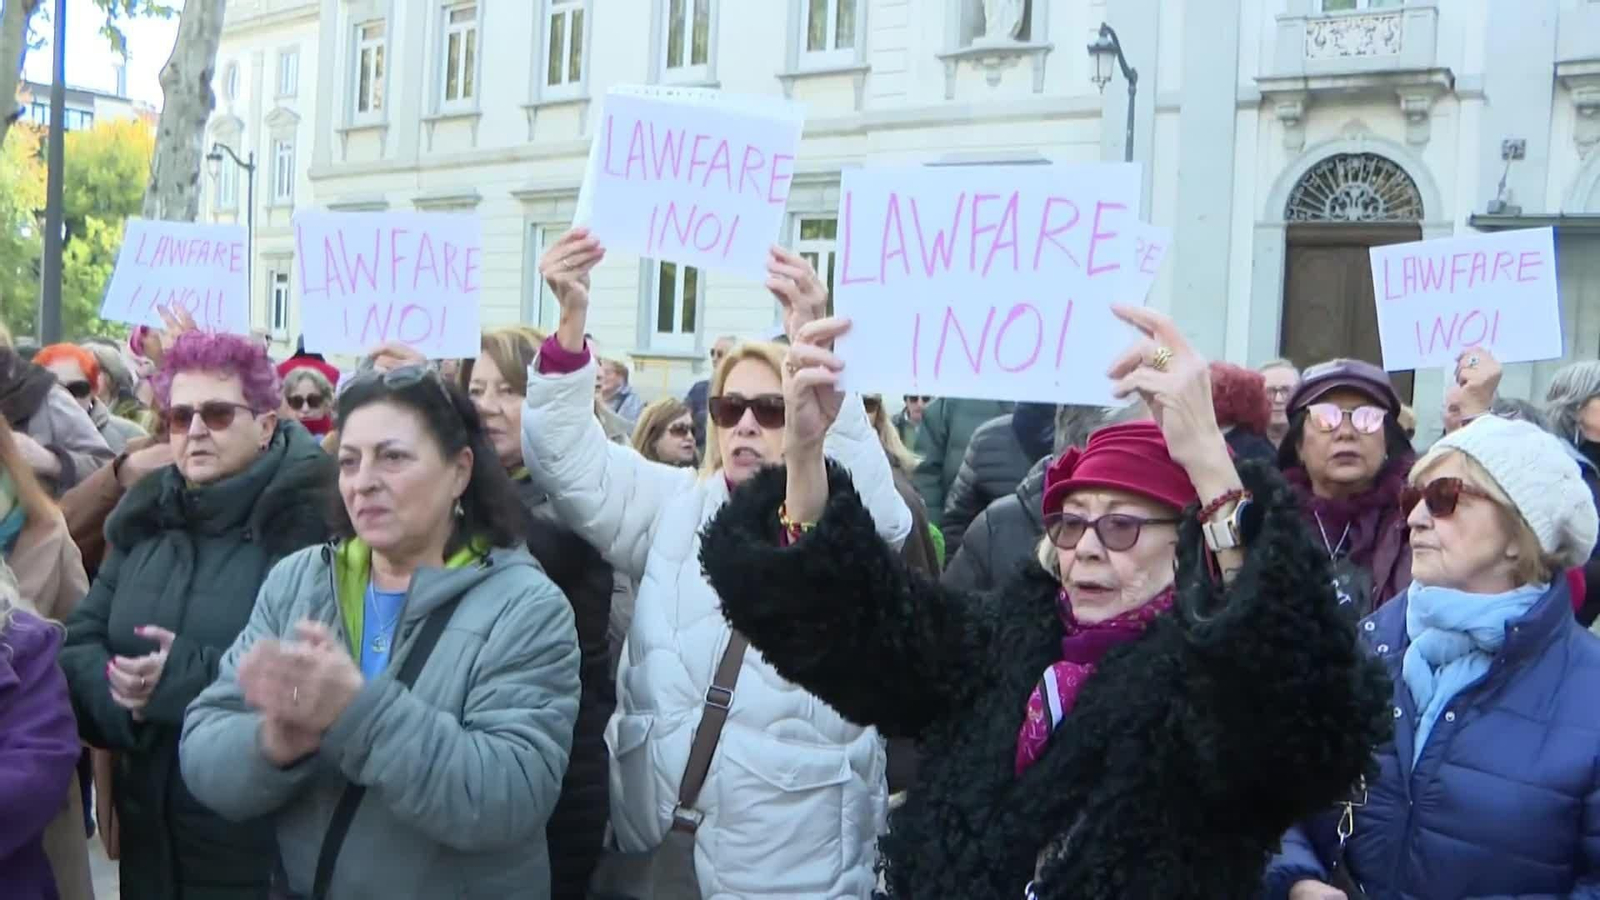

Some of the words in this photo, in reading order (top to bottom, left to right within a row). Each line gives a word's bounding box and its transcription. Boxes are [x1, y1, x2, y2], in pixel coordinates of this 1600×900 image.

[604, 115, 795, 204] LAWFARE
[135, 232, 244, 273] LAWFARE
[297, 224, 481, 299] LAWFARE
[841, 190, 1127, 284] LAWFARE
[1384, 251, 1544, 301] LAWFARE
